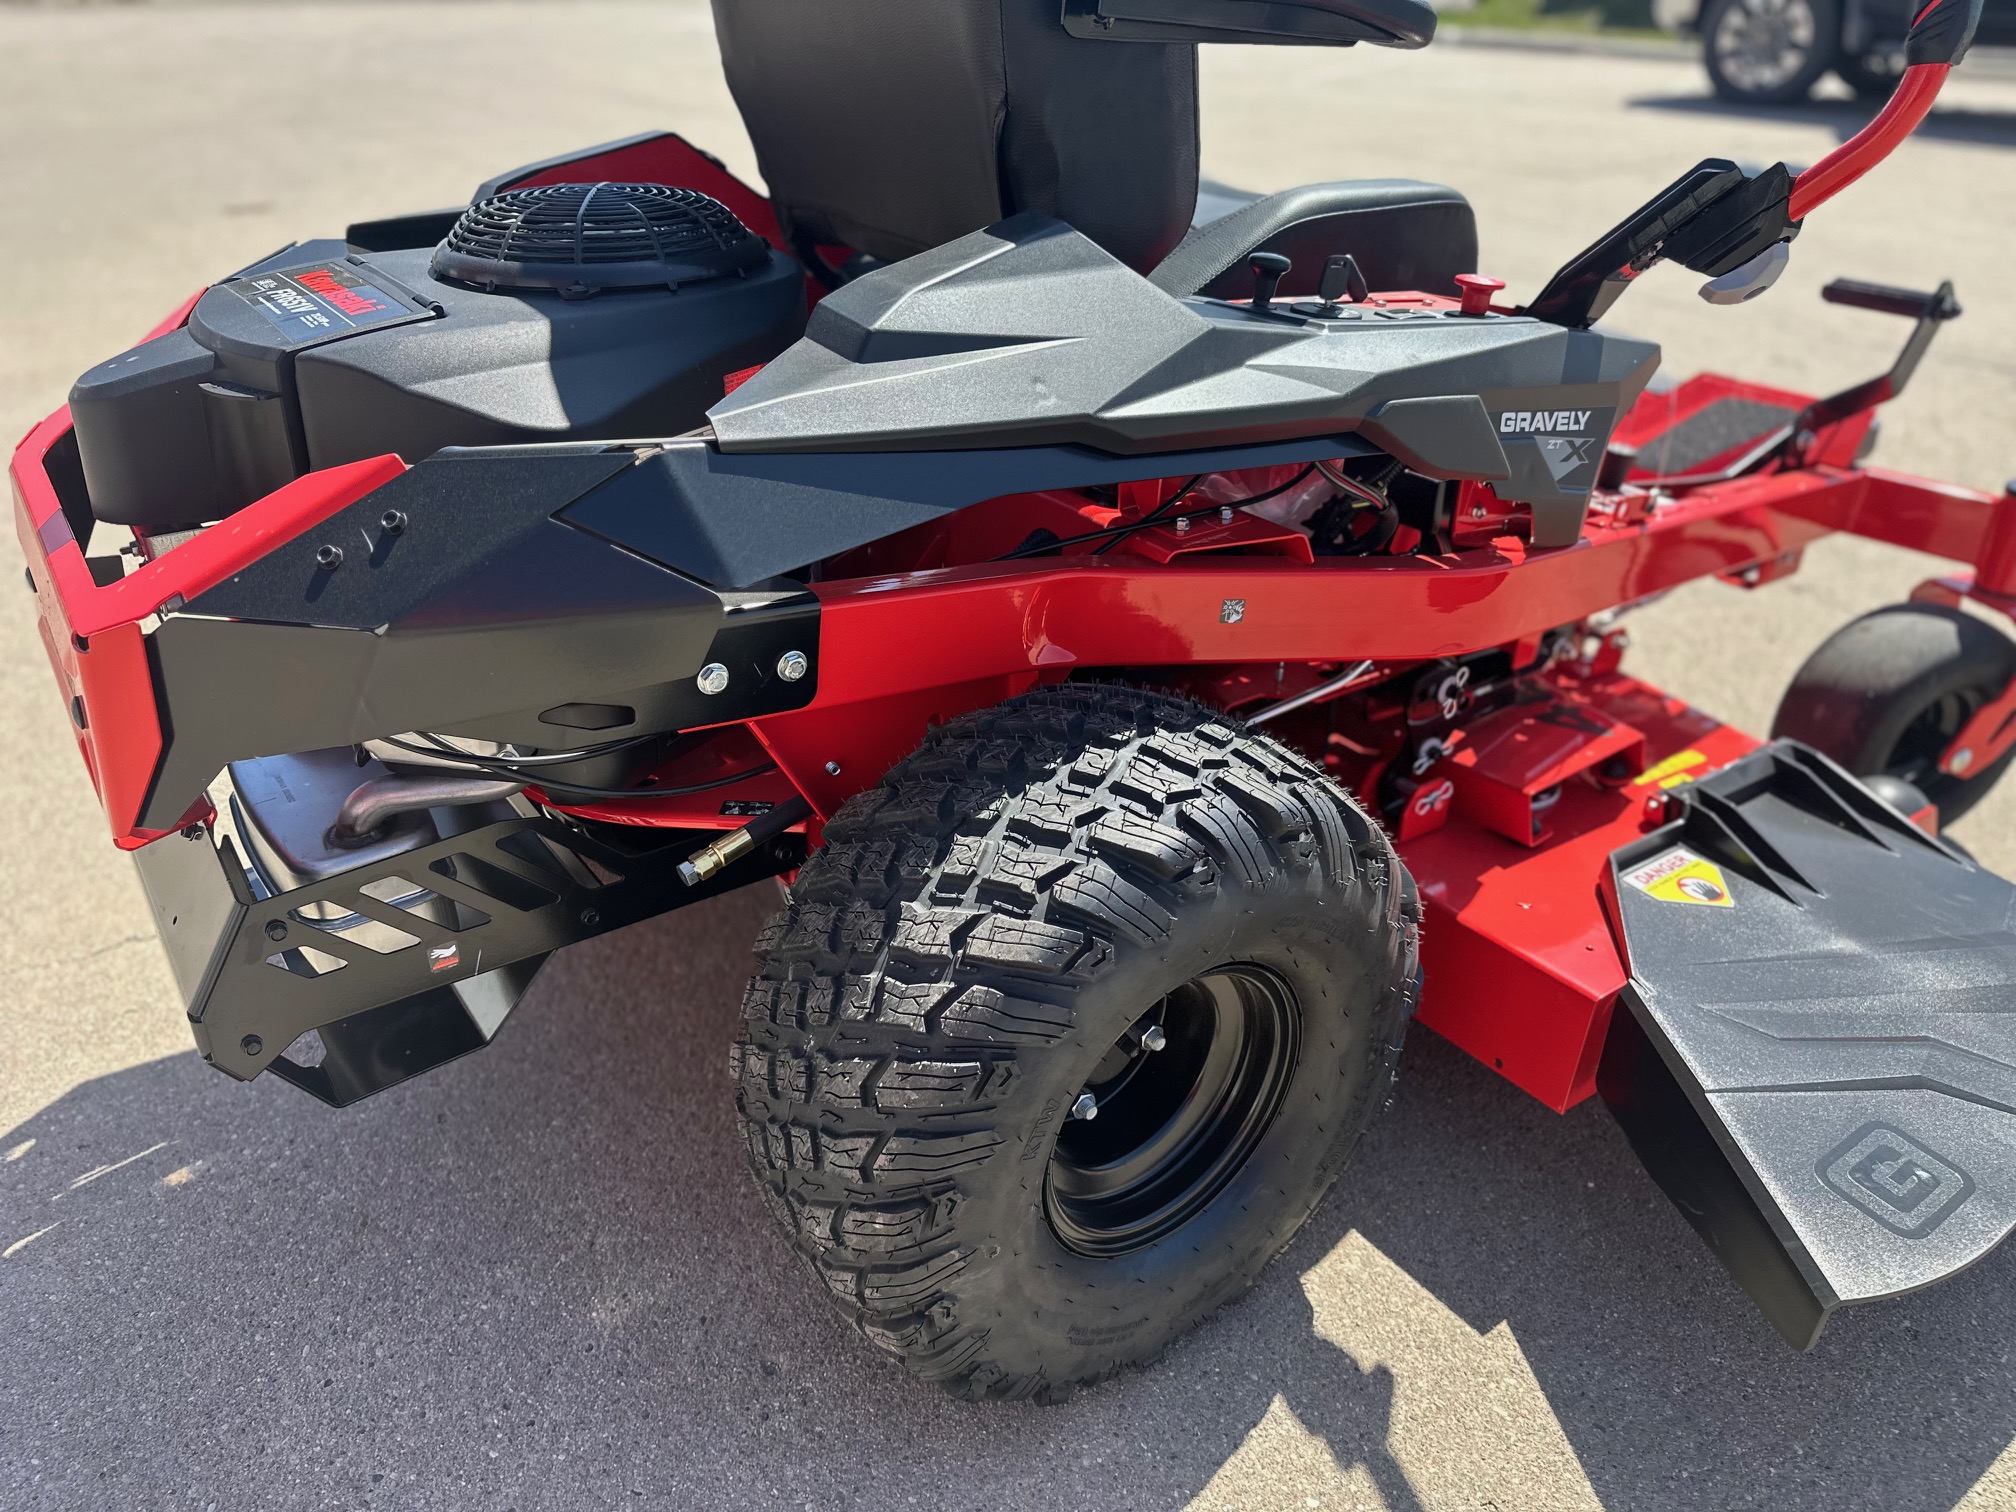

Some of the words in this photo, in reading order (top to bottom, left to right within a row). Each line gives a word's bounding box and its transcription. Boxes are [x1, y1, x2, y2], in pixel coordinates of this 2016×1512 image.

[266, 288, 318, 313] FR651V
[294, 270, 386, 316] Kawasaki
[1500, 411, 1591, 433] GRAVELY
[1546, 440, 1563, 449] ZT
[1559, 438, 1596, 463] X
[1634, 855, 1690, 884] DANGER
